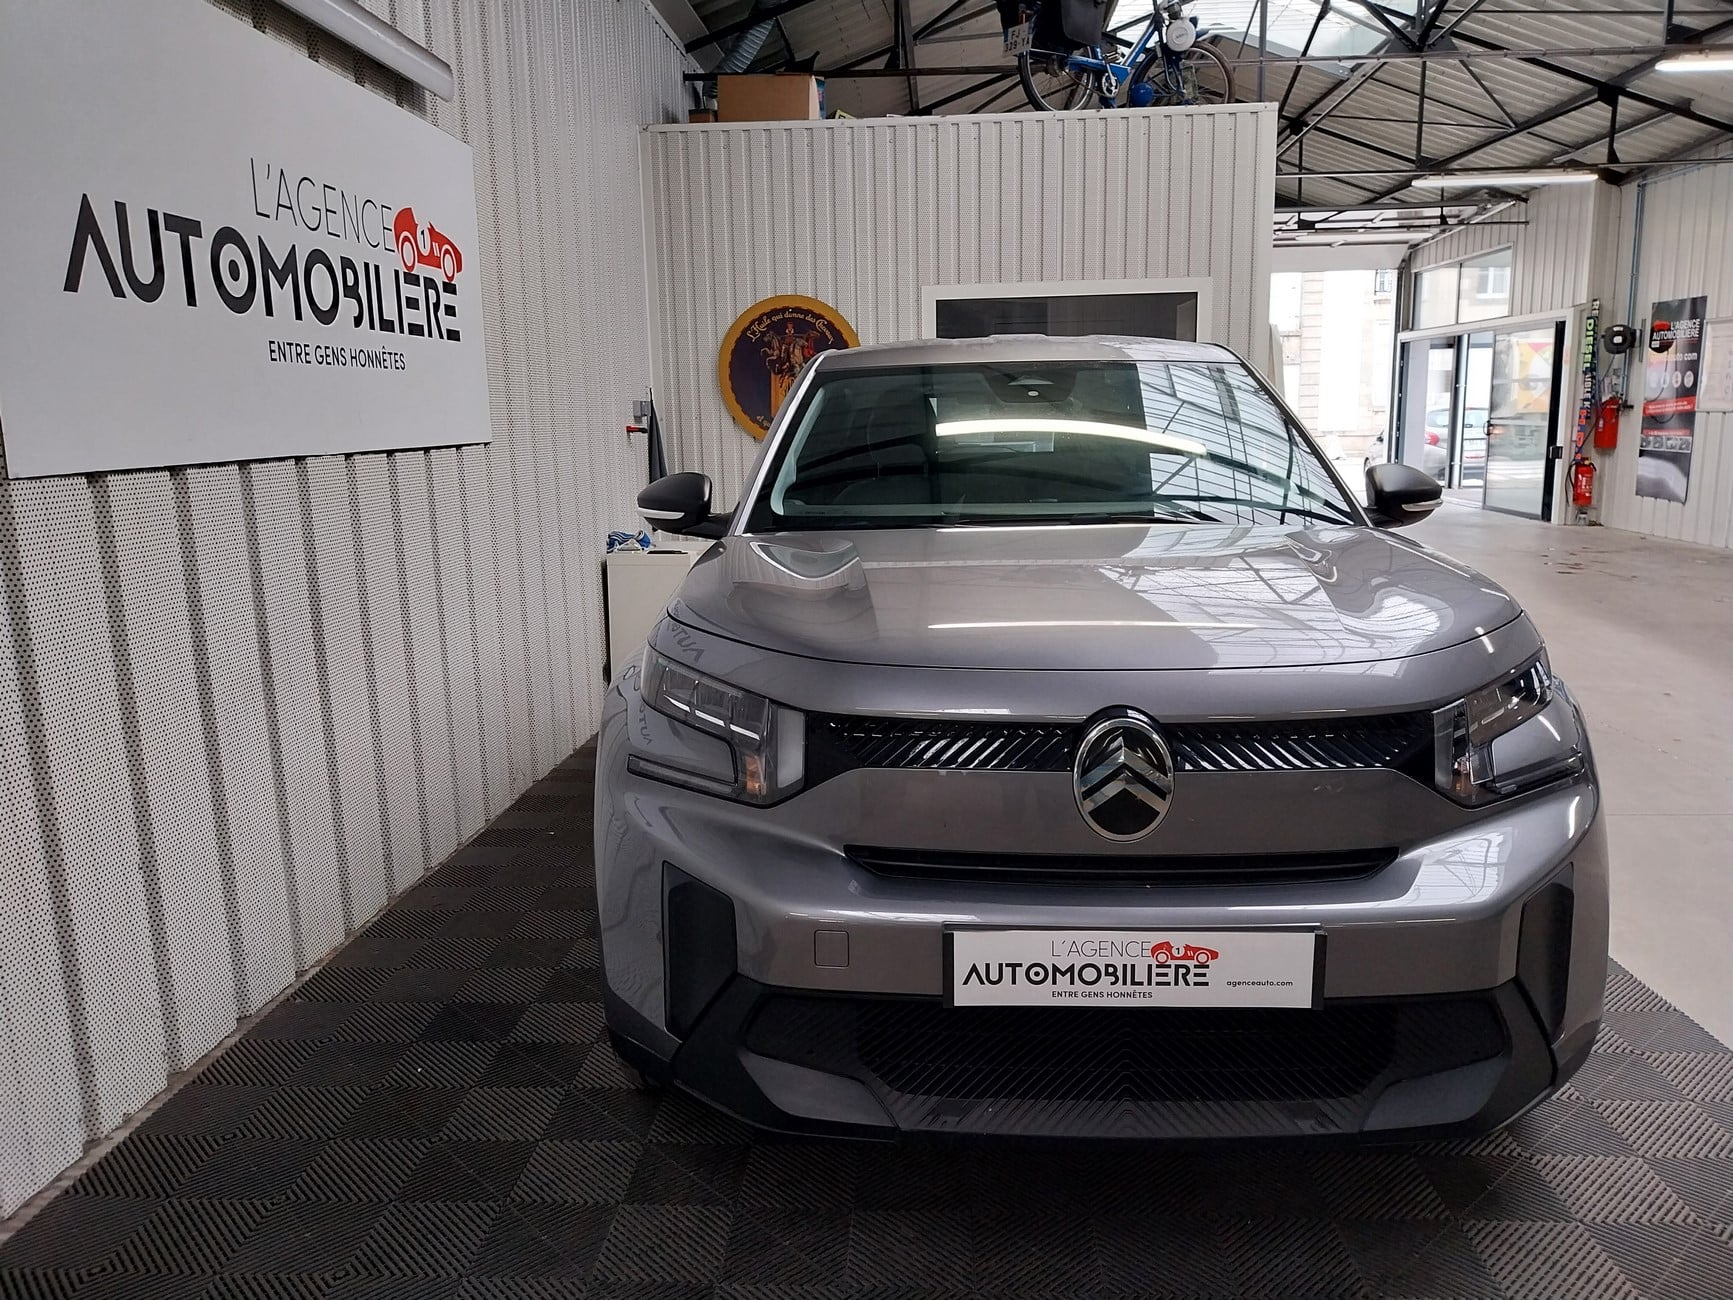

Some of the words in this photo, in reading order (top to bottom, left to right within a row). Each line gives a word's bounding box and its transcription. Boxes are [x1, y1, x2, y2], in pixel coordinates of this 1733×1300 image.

[250, 157, 396, 253] L'AGENCE
[1671, 319, 1700, 330] L'AGENCE
[1583, 318, 1594, 370] DIESEL
[268, 340, 312, 364] ENTRE
[314, 345, 347, 367] GENS
[349, 345, 406, 371] HONNÊTES
[1051, 940, 1152, 958] L'AGENCE
[1226, 980, 1294, 988] agenceauto.com
[1106, 989, 1153, 999] HONNÊTES
